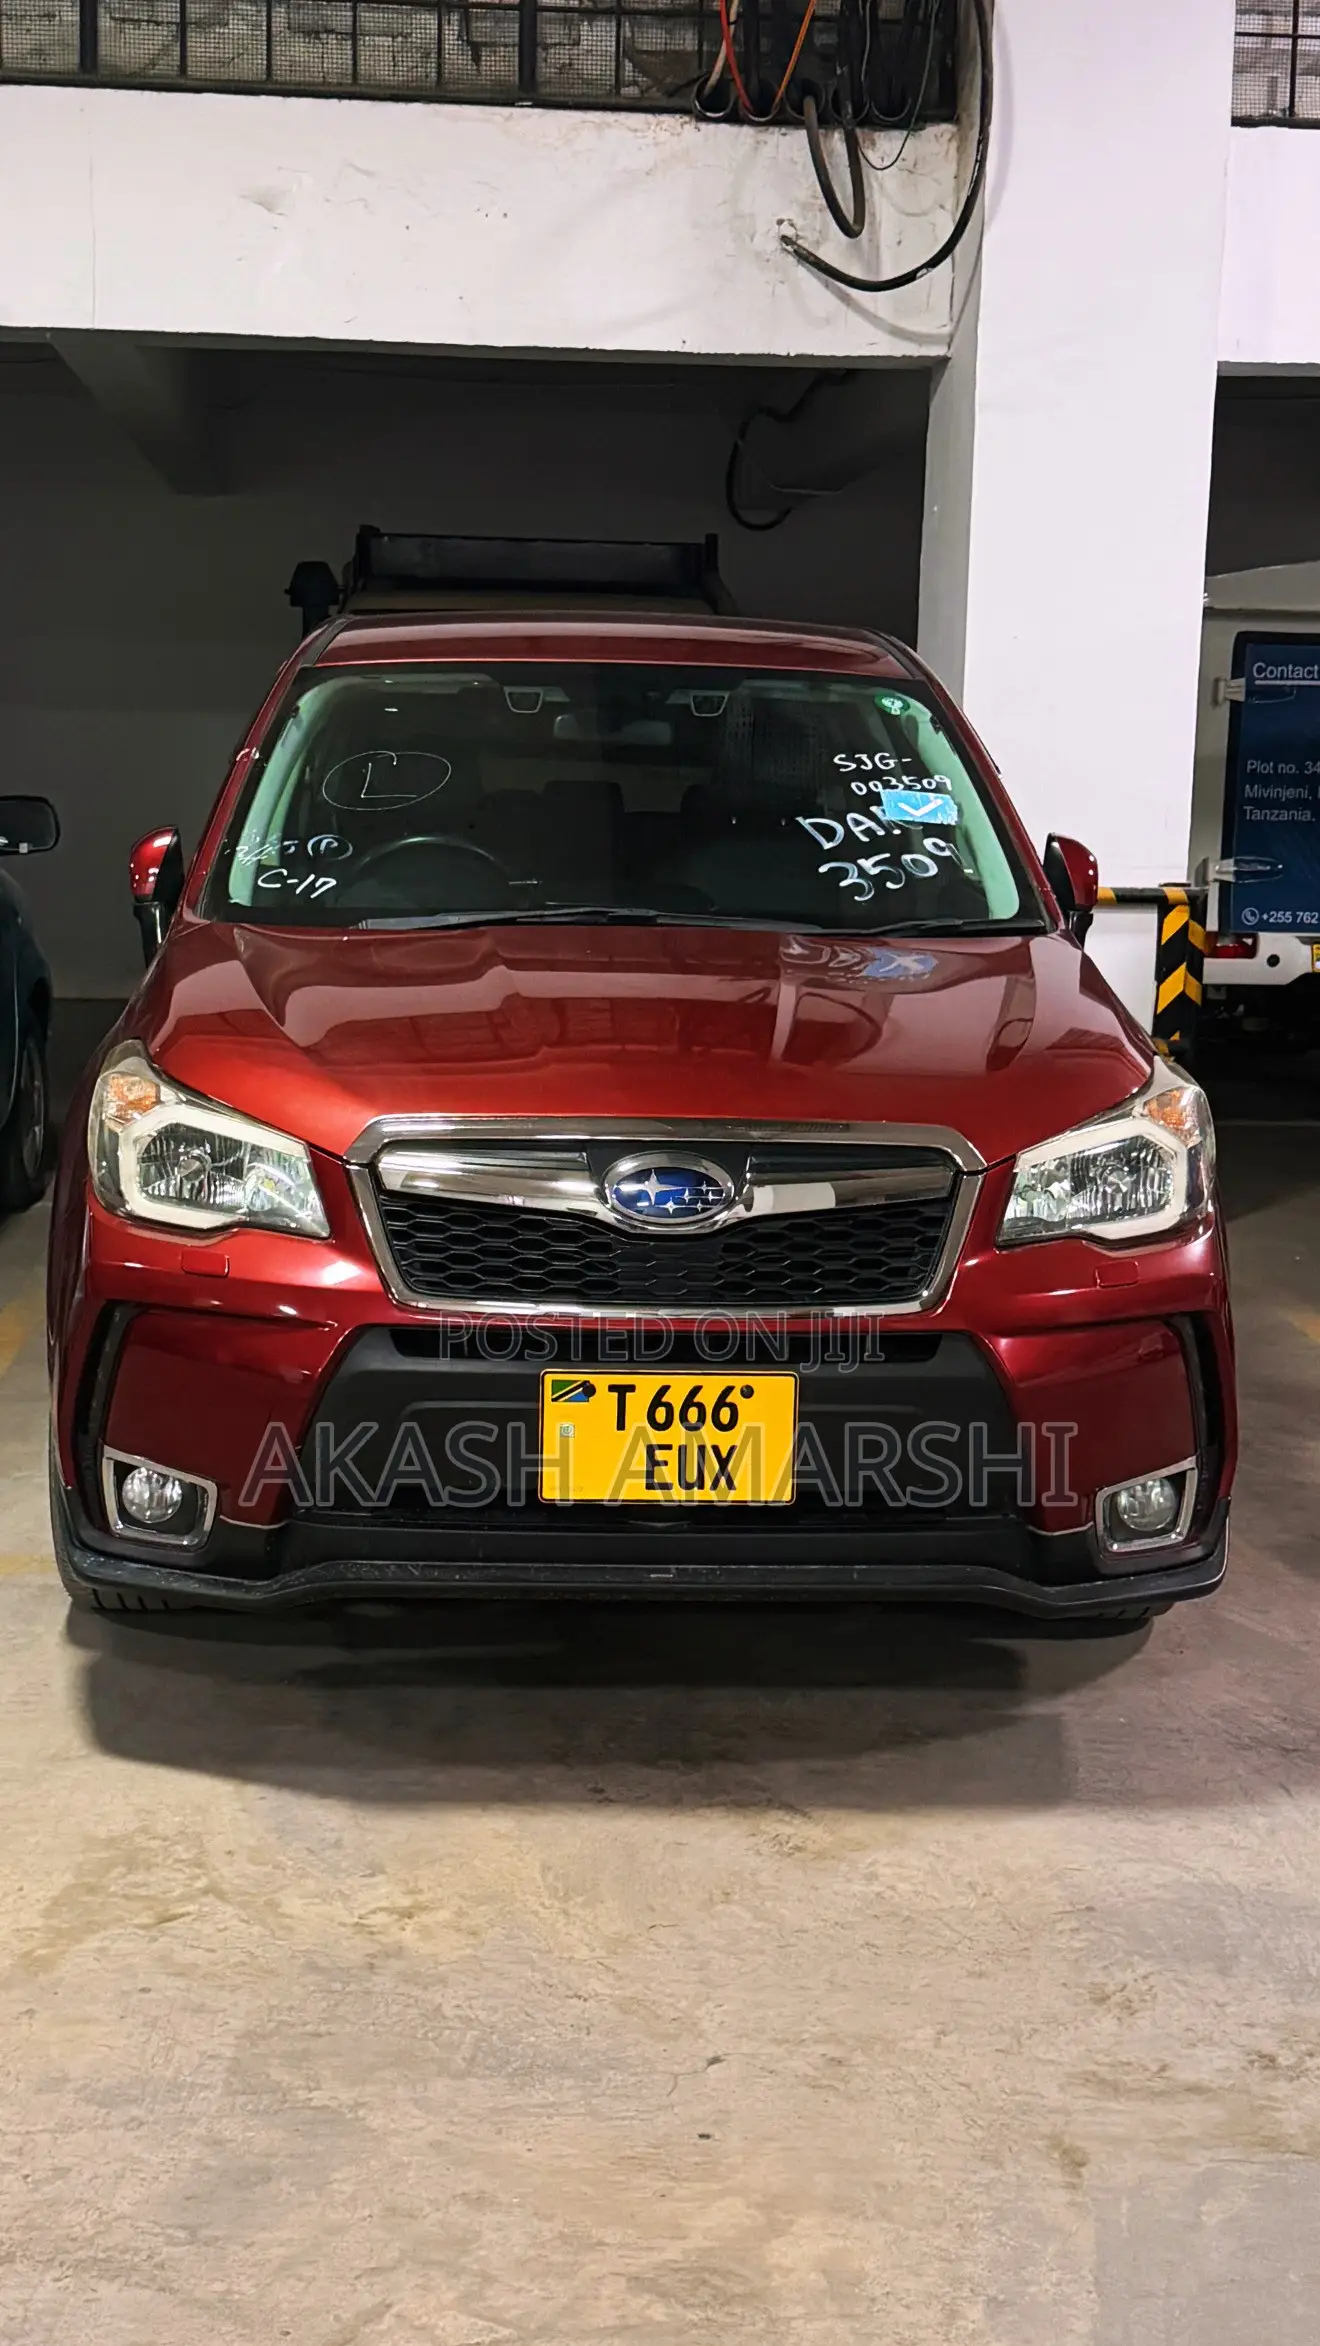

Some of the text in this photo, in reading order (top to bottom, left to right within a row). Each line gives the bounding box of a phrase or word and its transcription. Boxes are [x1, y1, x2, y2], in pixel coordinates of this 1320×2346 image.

[1252, 661, 1319, 679] Contact
[833, 752, 912, 772] SJG-
[1246, 759, 1274, 774] Plot
[1277, 763, 1299, 774] no.
[851, 774, 952, 796] 003509
[1243, 805, 1316, 822] Tanzania.
[818, 837, 974, 901] 3509
[257, 868, 337, 899] C-17
[1261, 911, 1319, 924] +255 762
[607, 1384, 740, 1432] T 666
[644, 1444, 736, 1491] EUX
